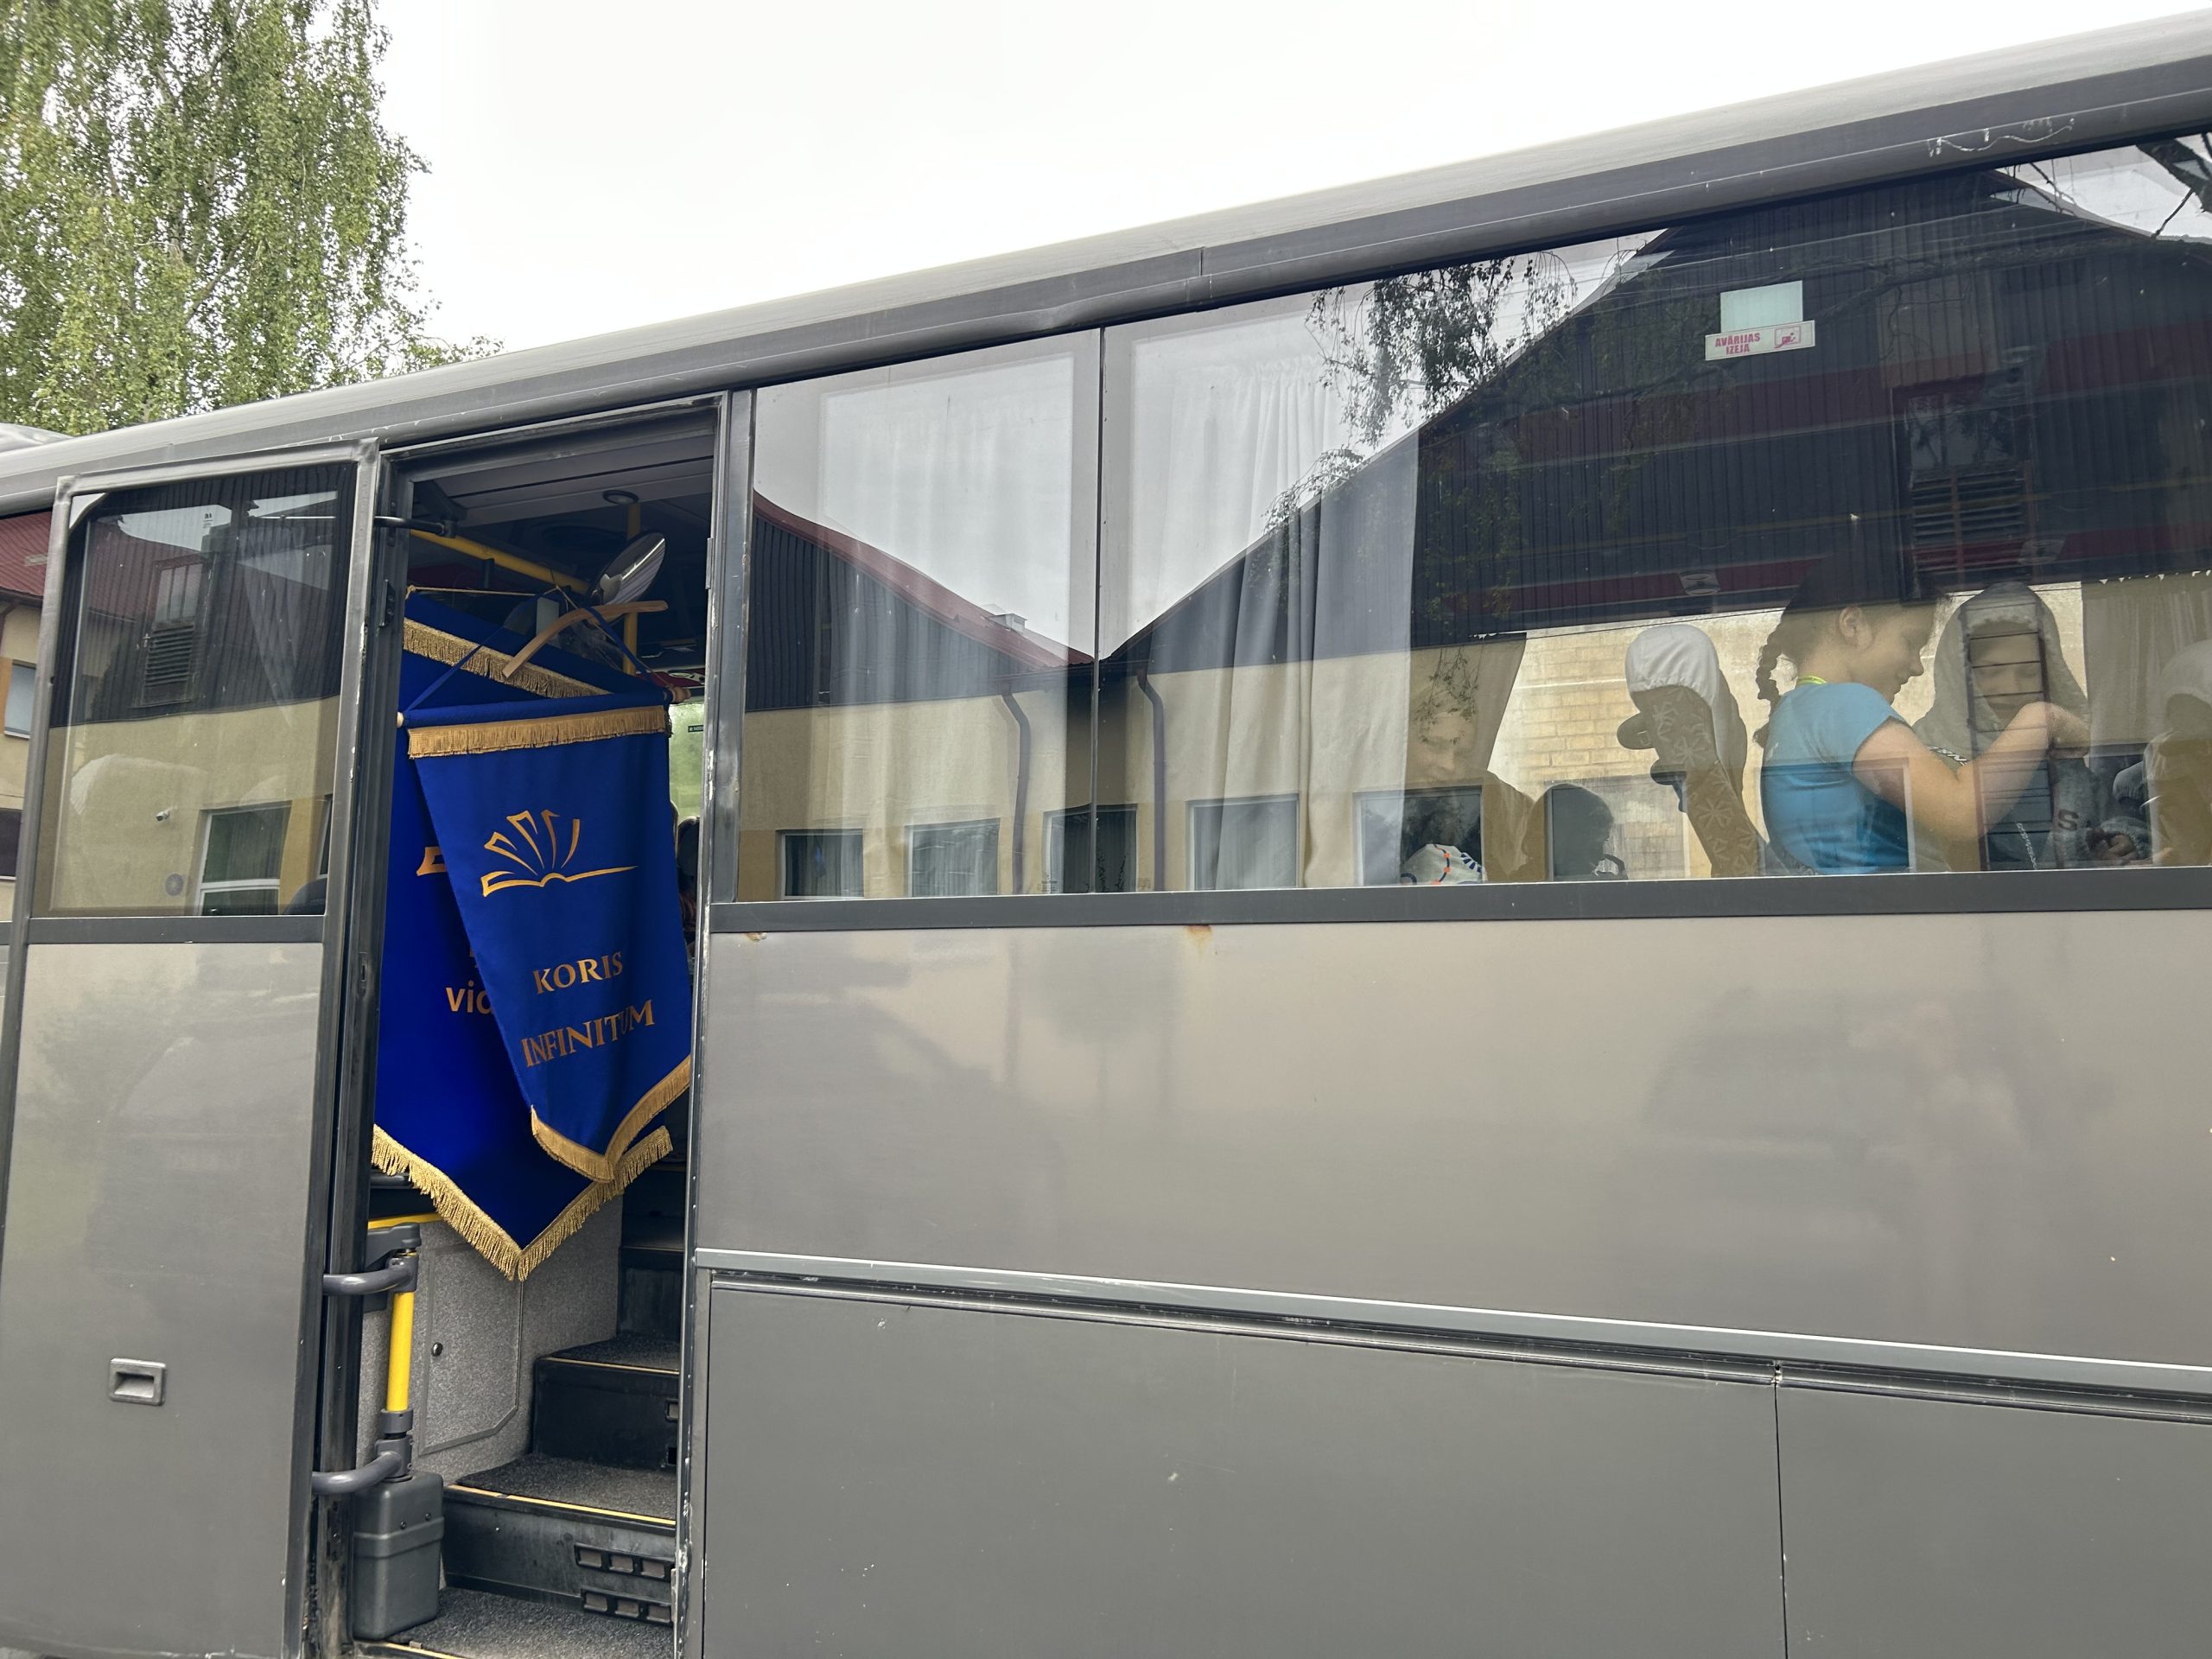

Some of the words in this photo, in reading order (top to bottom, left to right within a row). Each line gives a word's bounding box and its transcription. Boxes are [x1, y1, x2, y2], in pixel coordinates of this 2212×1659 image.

[1715, 334, 1760, 347] AVĀRIJAS
[1726, 344, 1750, 354] IZEJA
[532, 951, 624, 995] KORIS
[521, 1000, 655, 1067] INFINITUM
